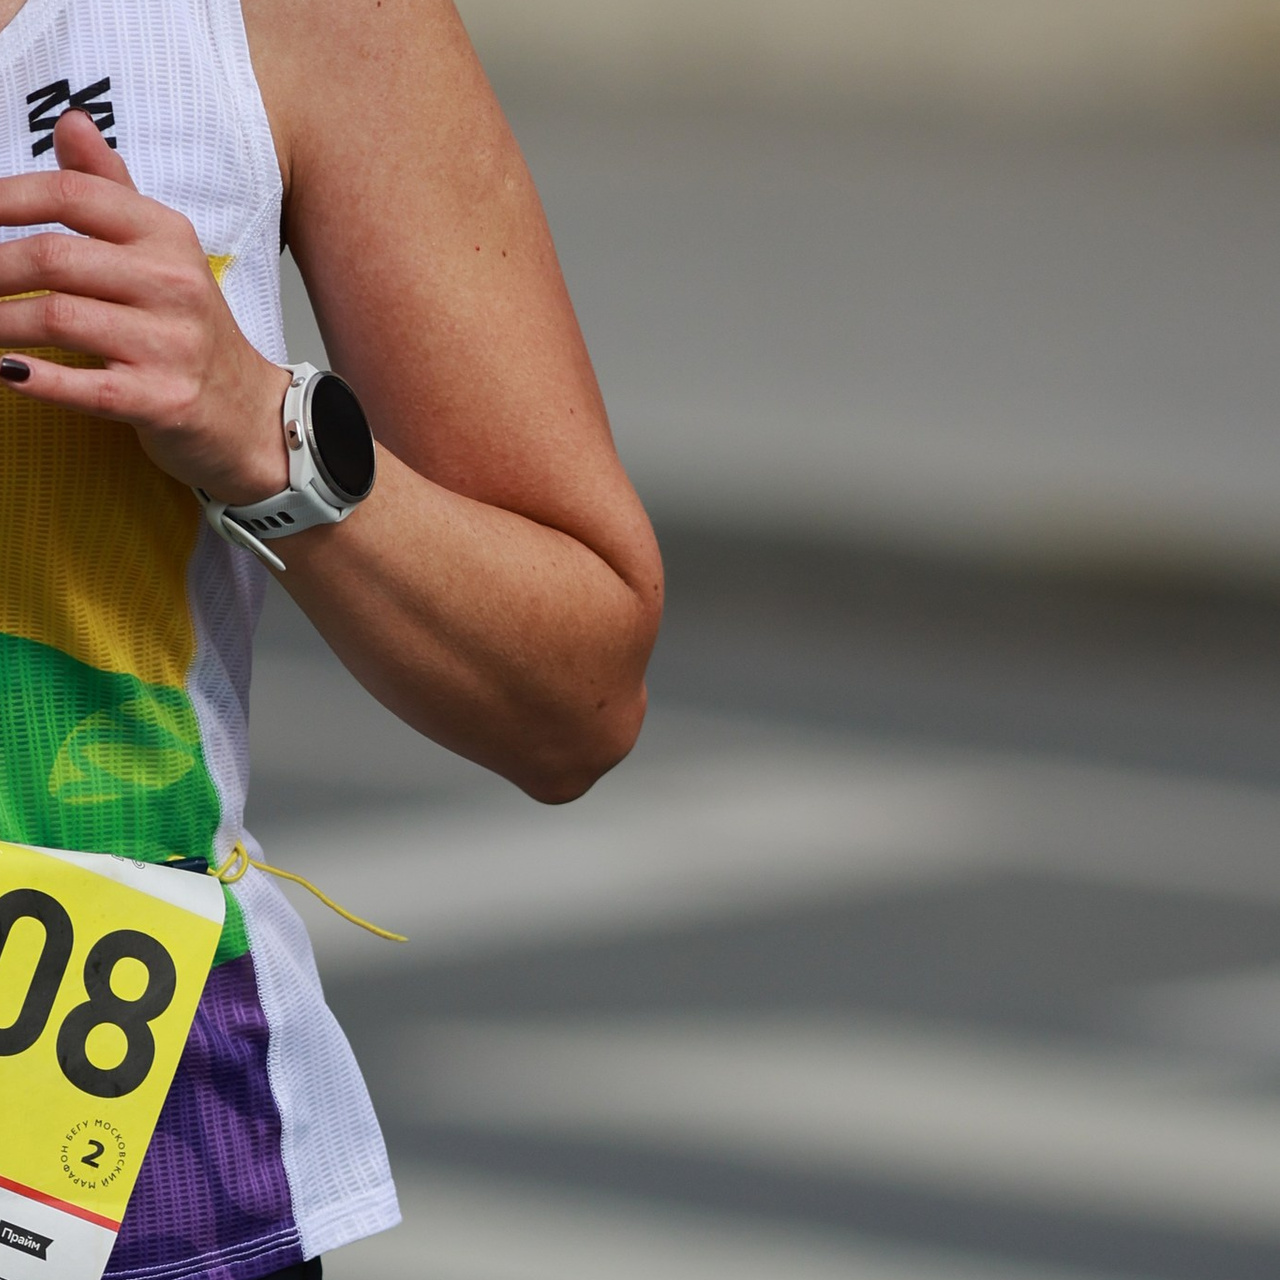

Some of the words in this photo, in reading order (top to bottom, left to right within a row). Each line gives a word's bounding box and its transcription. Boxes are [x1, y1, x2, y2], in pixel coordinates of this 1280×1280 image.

[65, 1120, 89, 1141] БЕГУ
[60, 1145, 96, 1189] МАРАФОН
[80, 1139, 105, 1169] 2
[0, 1227, 41, 1251] Прайм
